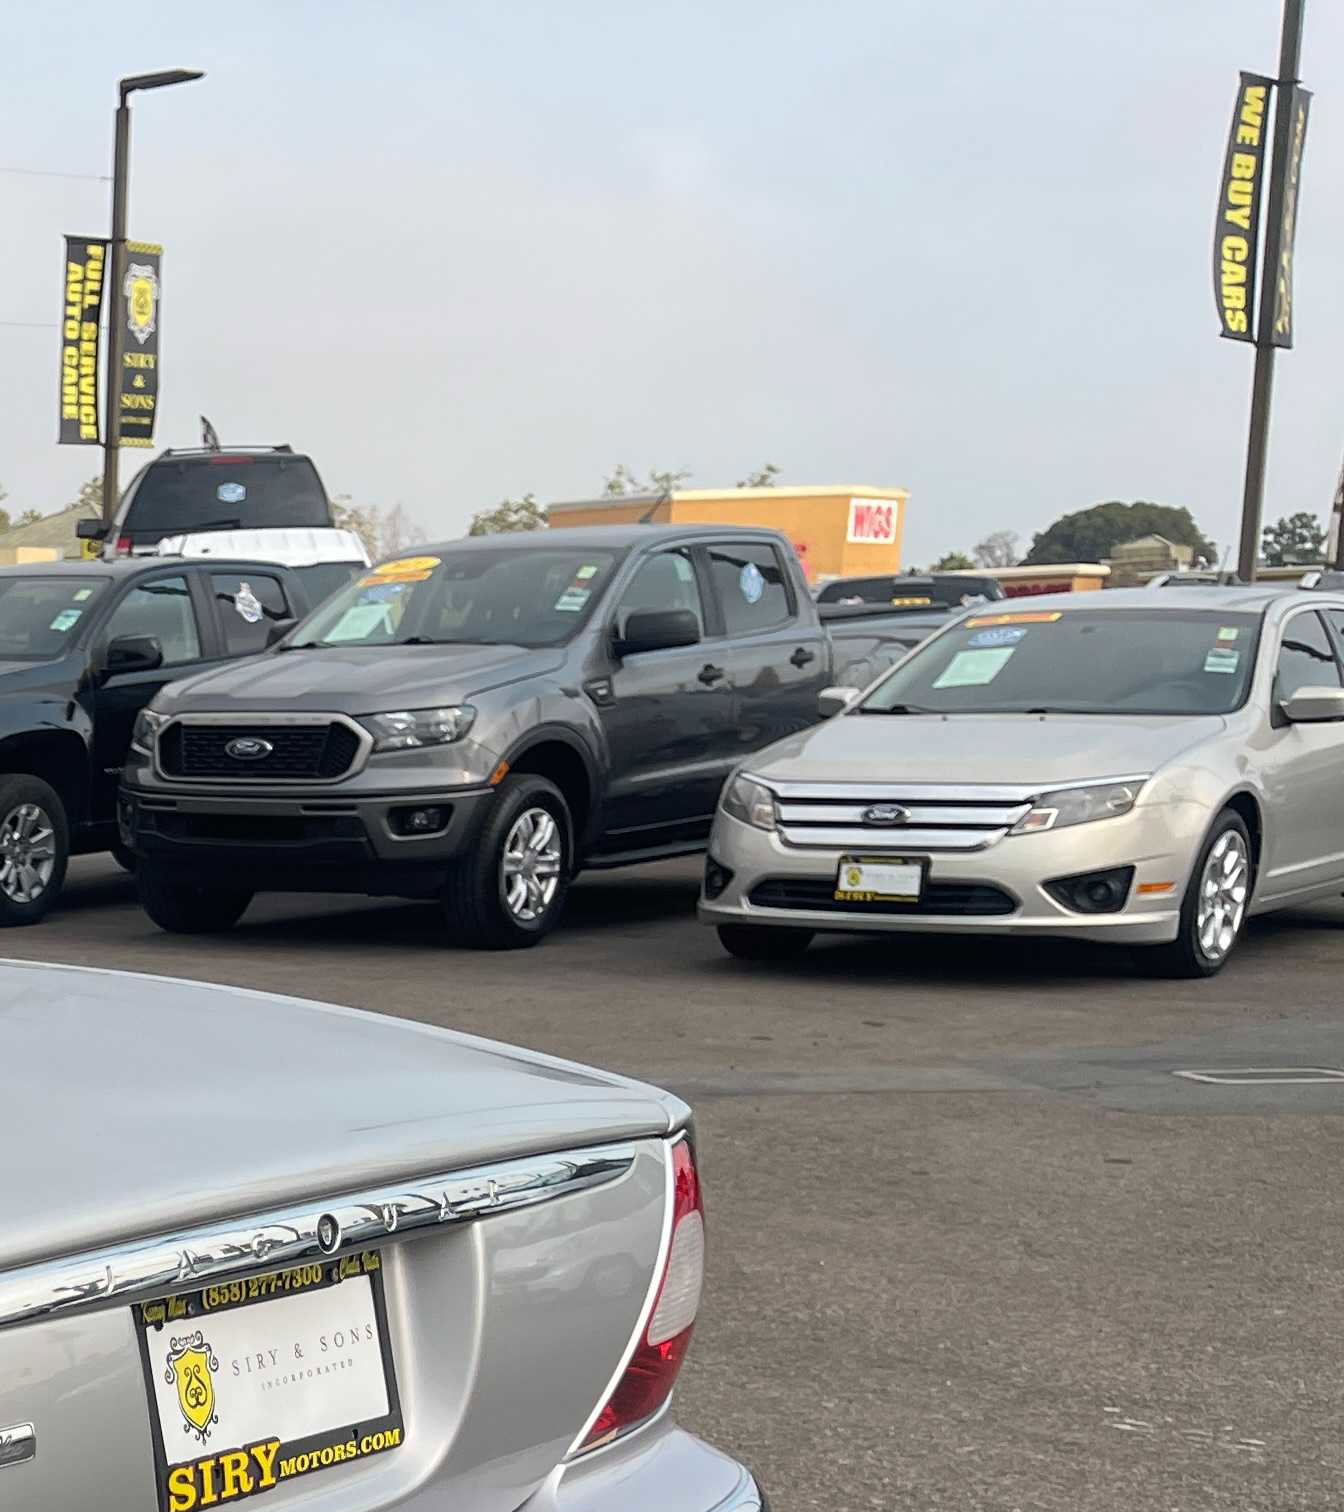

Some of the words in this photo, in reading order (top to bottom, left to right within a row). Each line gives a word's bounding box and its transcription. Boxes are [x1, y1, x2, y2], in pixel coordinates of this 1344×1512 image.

[1237, 86, 1266, 146] WE
[1225, 153, 1256, 229] BUY
[1221, 235, 1249, 334] CARS
[231, 1348, 278, 1377] SIRY
[293, 1342, 305, 1360] &
[319, 1323, 374, 1353] SONS
[261, 1358, 354, 1392] INCORPORATED
